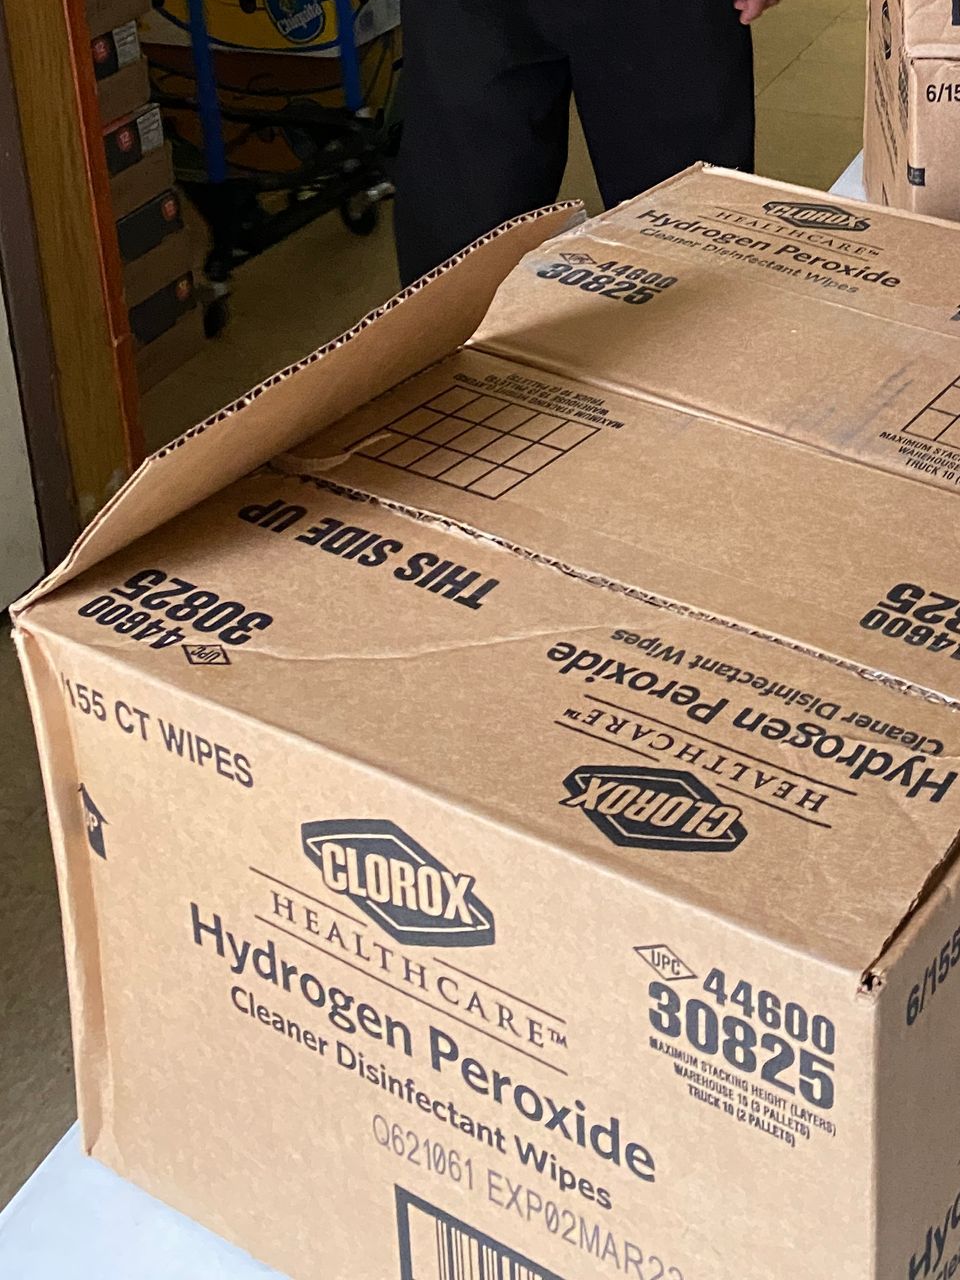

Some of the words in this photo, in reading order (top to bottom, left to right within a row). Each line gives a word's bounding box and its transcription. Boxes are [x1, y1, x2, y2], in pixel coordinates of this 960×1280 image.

[636, 209, 771, 252] Hydrogen
[774, 243, 901, 288] Peroxide
[767, 203, 871, 231] CLOROX
[536, 263, 664, 305] 30825
[597, 261, 678, 289] 44600
[640, 226, 702, 249] Cleaner
[702, 243, 803, 277] Disinfectant
[804, 271, 860, 294] Wipes
[879, 431, 932, 452] MAXIMUM
[904, 458, 940, 476] TRUCK
[942, 470, 955, 480] 10
[238, 499, 308, 533] UP
[294, 517, 403, 567] SIDE
[110, 569, 274, 645] 30825
[393, 552, 500, 610] THIS
[77, 595, 187, 649] 44600
[190, 646, 223, 663] UPC
[611, 628, 686, 664] Wipes
[546, 640, 730, 724] Peroxide
[688, 652, 841, 721] Disinfectant
[114, 700, 150, 741] CT
[157, 718, 254, 788] WIPES
[732, 701, 960, 804] Hydrogen
[840, 708, 946, 756] Cleaner
[562, 775, 745, 838] CLOROX
[321, 841, 476, 926] CLOROX
[651, 949, 681, 976] UPC
[702, 967, 836, 1055] 44600
[190, 901, 414, 1057] Hydrogen
[428, 1024, 657, 1182] Peroxide
[648, 980, 836, 1110] 30825
[230, 985, 328, 1056] Cleaner
[336, 1039, 507, 1153] Disinfectant
[513, 1134, 613, 1211] Wipes
[649, 1035, 699, 1068] MAXIMUM
[701, 1060, 749, 1093] STACKING
[751, 1083, 787, 1110] HEIGHT
[790, 1102, 837, 1138] (LAYERS)
[673, 1062, 734, 1099] WAREHOUSE
[763, 1103, 811, 1140] PALLETS)
[687, 1083, 721, 1109] TRUCK
[736, 1107, 747, 1122] (2
[749, 1112, 796, 1148] PALLETS)
[371, 1113, 474, 1192] Q621061
